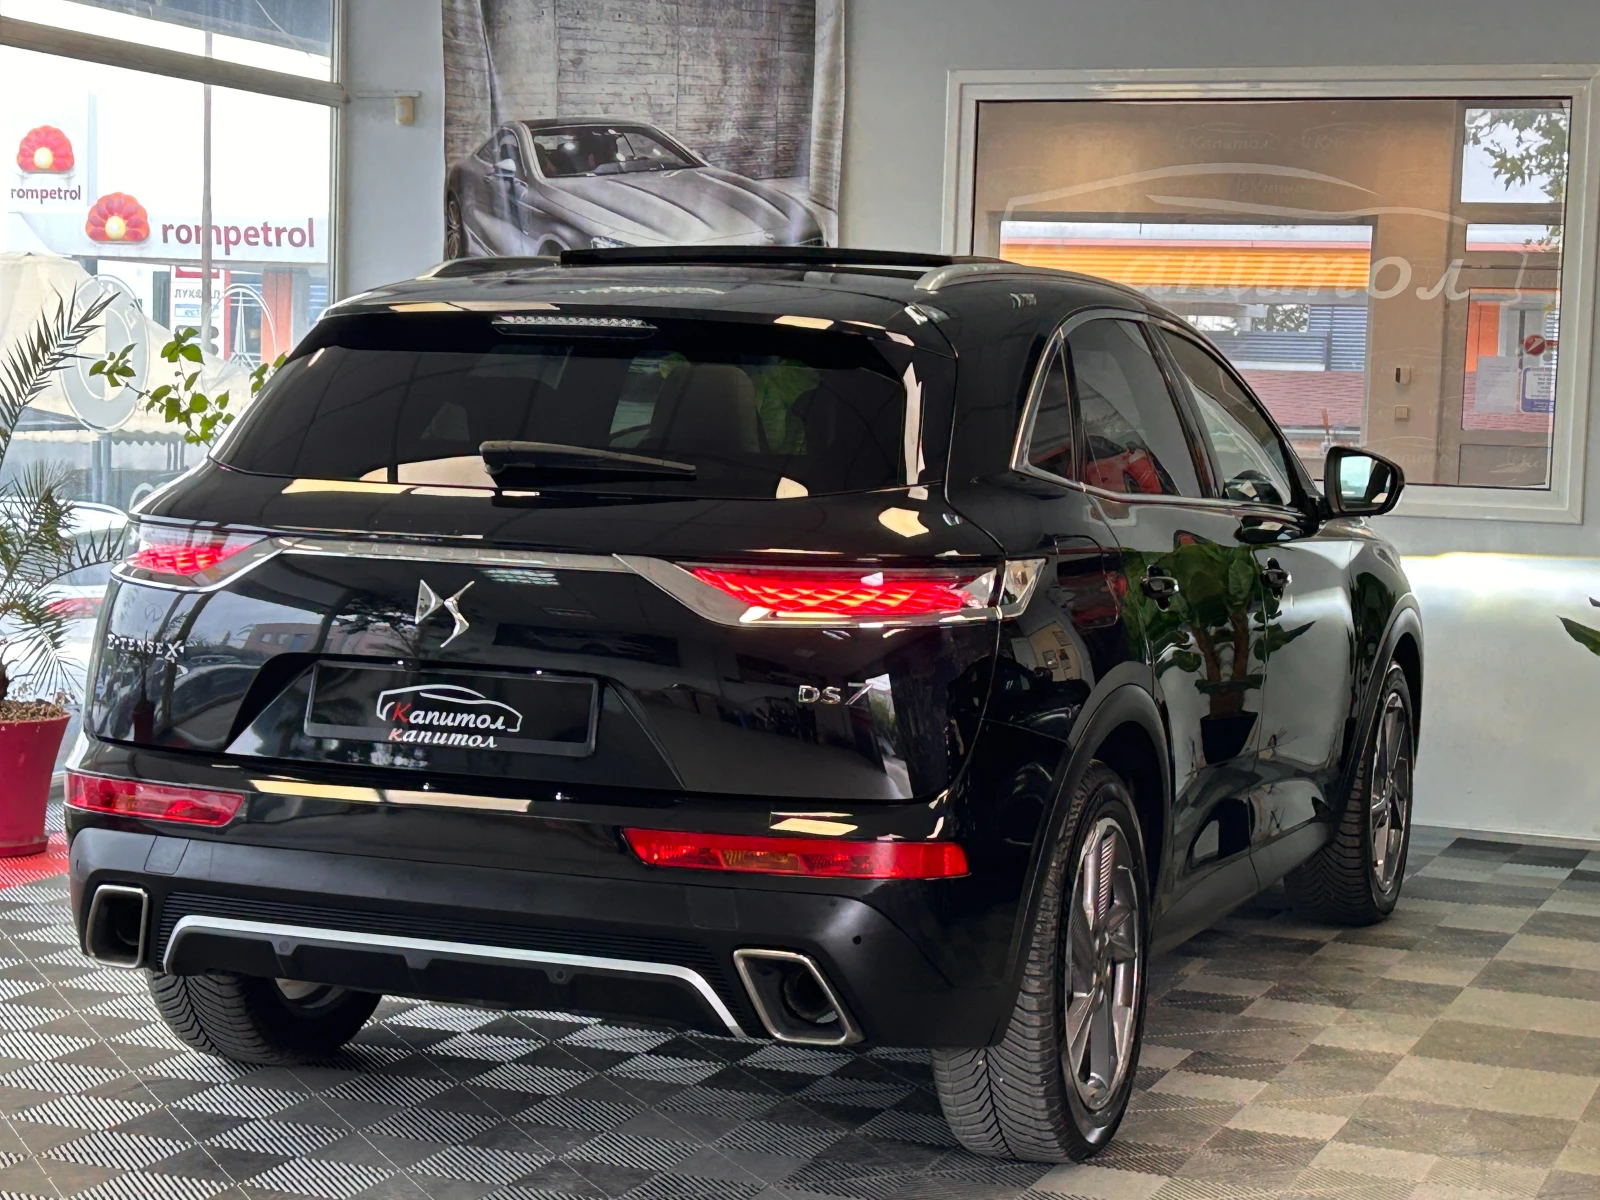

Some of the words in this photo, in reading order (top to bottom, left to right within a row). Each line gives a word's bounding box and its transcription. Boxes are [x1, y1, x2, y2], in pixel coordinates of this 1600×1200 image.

[10, 185, 81, 204] rompetrol
[1119, 253, 1470, 300] апитол
[174, 288, 220, 300] ЛУКОЛ
[391, 702, 506, 730] Капитол
